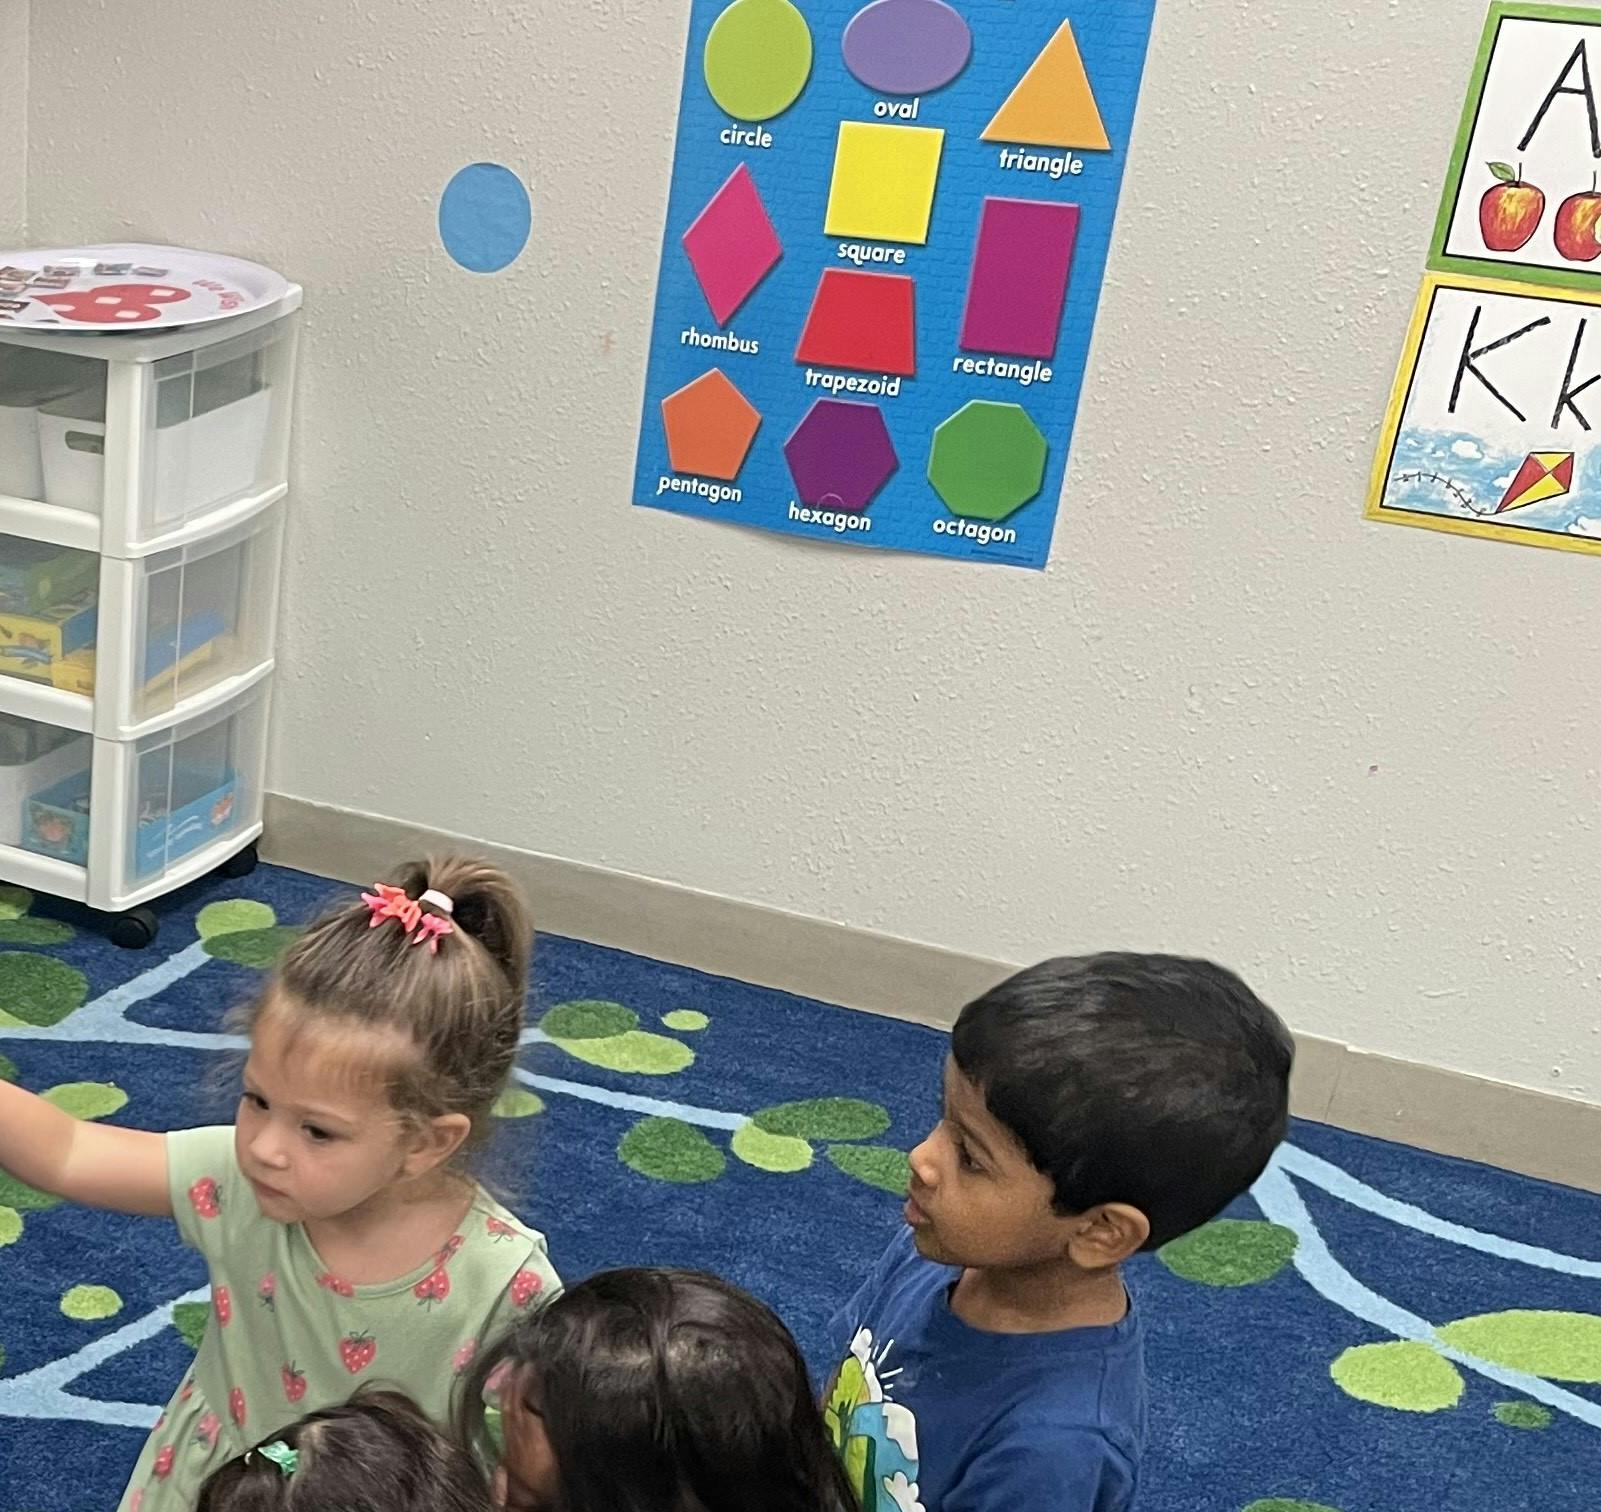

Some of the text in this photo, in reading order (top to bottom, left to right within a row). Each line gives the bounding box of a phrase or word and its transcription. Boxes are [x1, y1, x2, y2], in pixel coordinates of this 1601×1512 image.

[873, 97, 919, 120] oval
[1517, 38, 1601, 158] A
[719, 126, 773, 148] circle
[999, 149, 1083, 178] triangle
[837, 242, 906, 266] square
[680, 327, 759, 354] rhombus
[952, 357, 1053, 384] rectangle
[1447, 304, 1601, 431] Kk
[805, 368, 900, 397] trapezoid
[656, 476, 742, 503] pentagon
[788, 500, 872, 532] hexagon
[932, 517, 1016, 545] octagon
